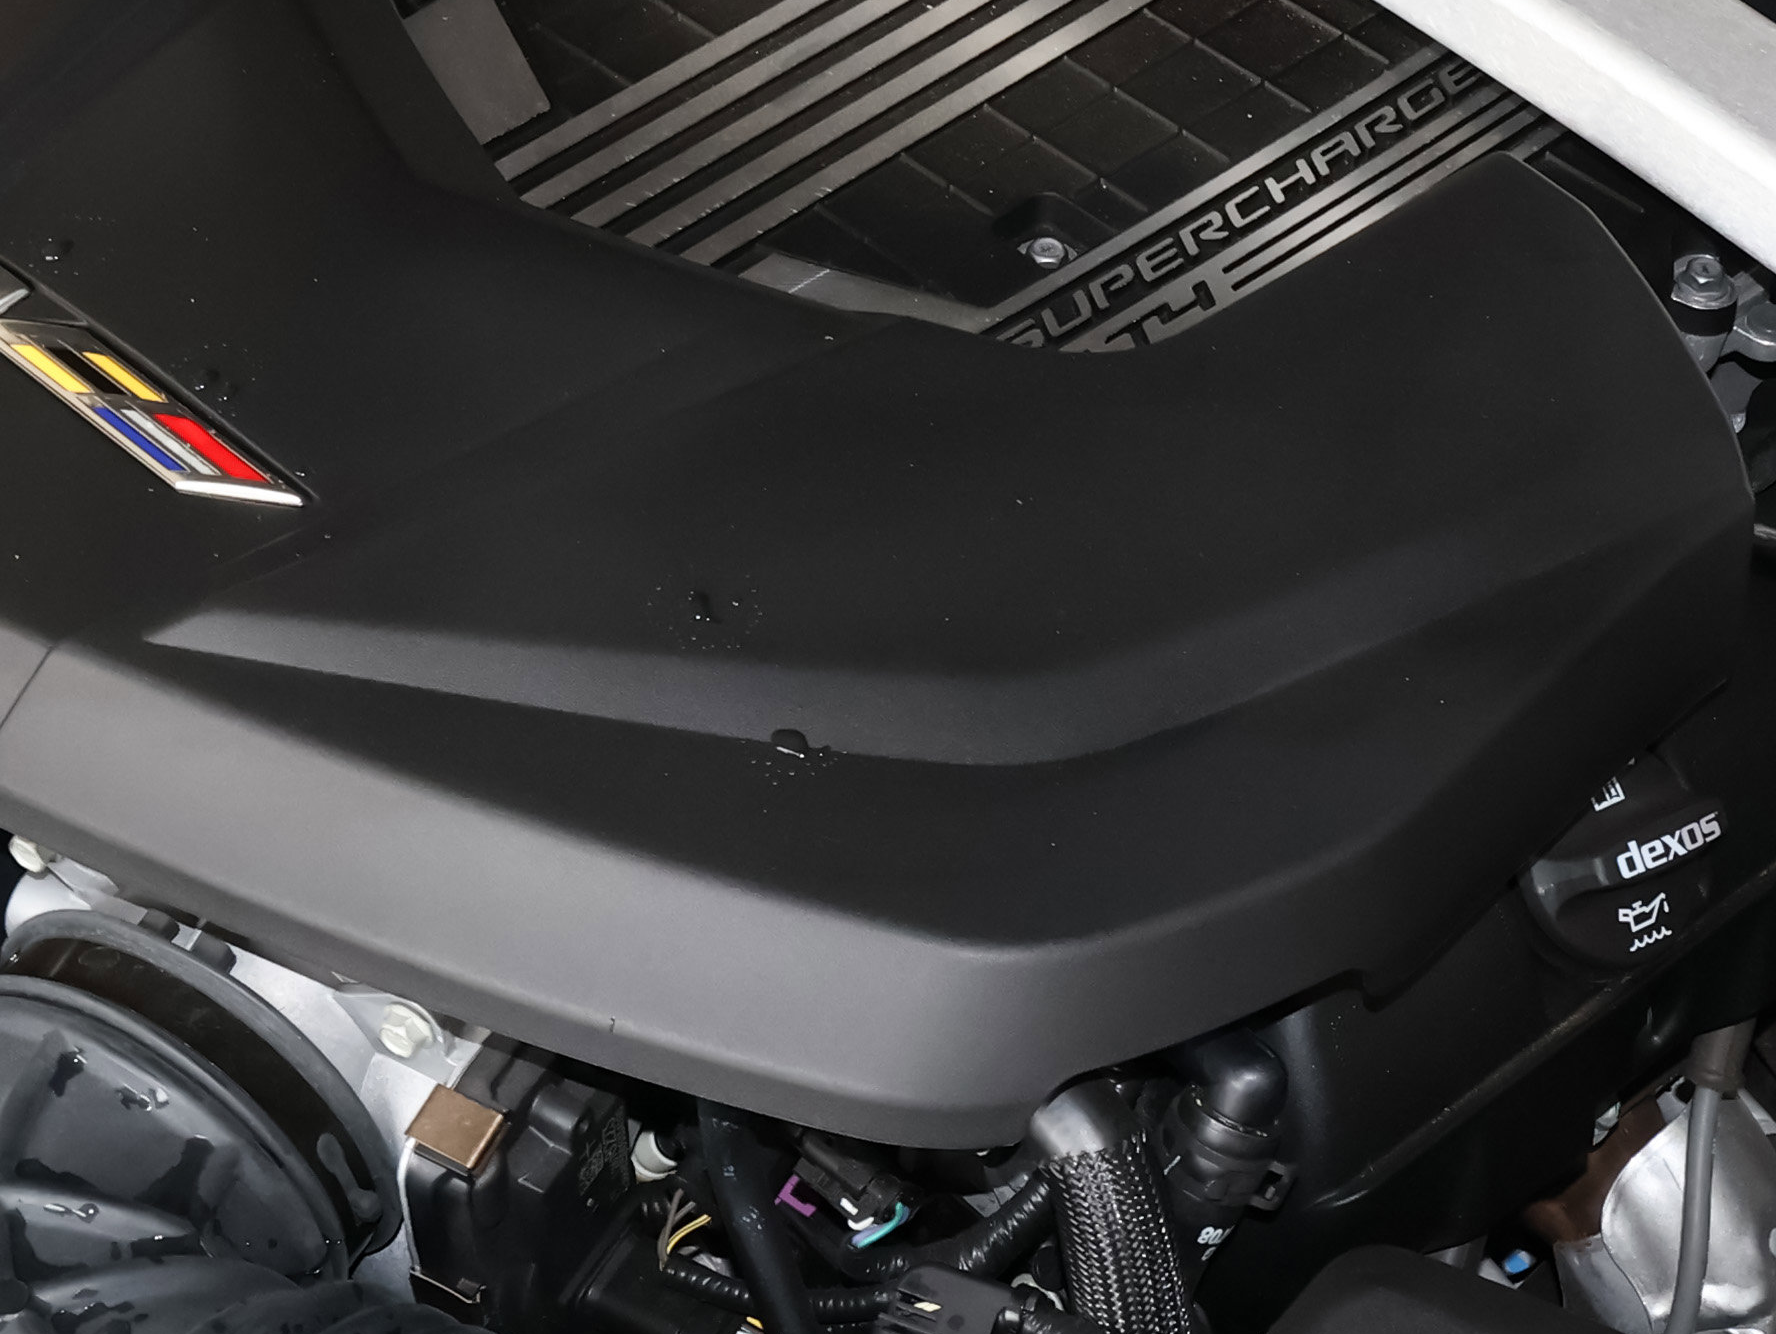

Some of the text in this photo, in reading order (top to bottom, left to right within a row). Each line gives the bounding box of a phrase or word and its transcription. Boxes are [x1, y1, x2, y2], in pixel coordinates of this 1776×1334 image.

[997, 62, 1484, 351] SUPERCHARGE
[1102, 279, 1218, 346] T4
[1616, 812, 1723, 880] dexos
